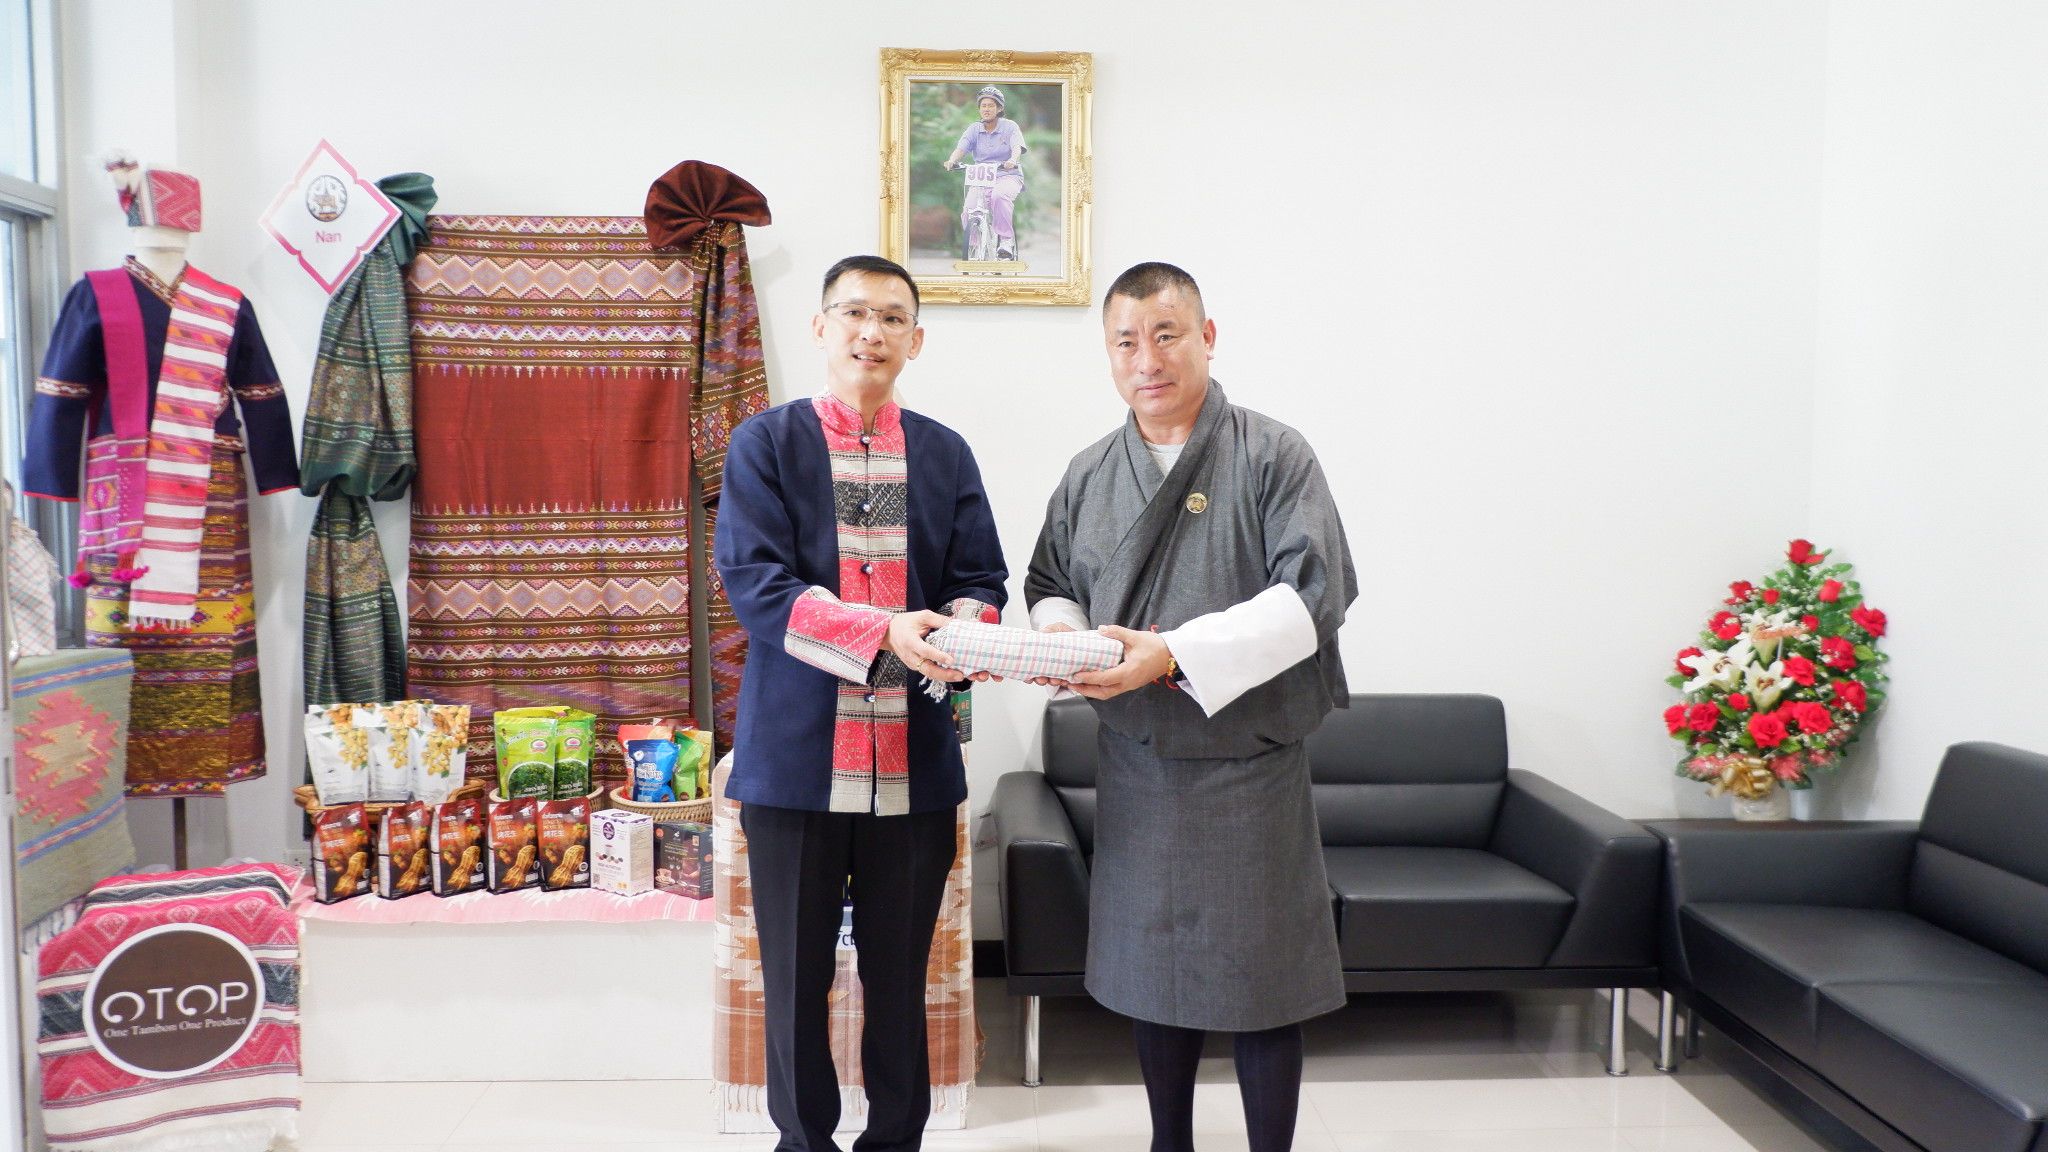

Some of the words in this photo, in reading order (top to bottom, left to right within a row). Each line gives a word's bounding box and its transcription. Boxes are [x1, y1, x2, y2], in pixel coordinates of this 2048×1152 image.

[314, 230, 342, 243] Nan
[101, 981, 249, 1024] OTOP
[103, 1028, 129, 1038] One
[132, 1023, 178, 1036] Tambon
[178, 1020, 203, 1031] One
[204, 1016, 248, 1029] Product
